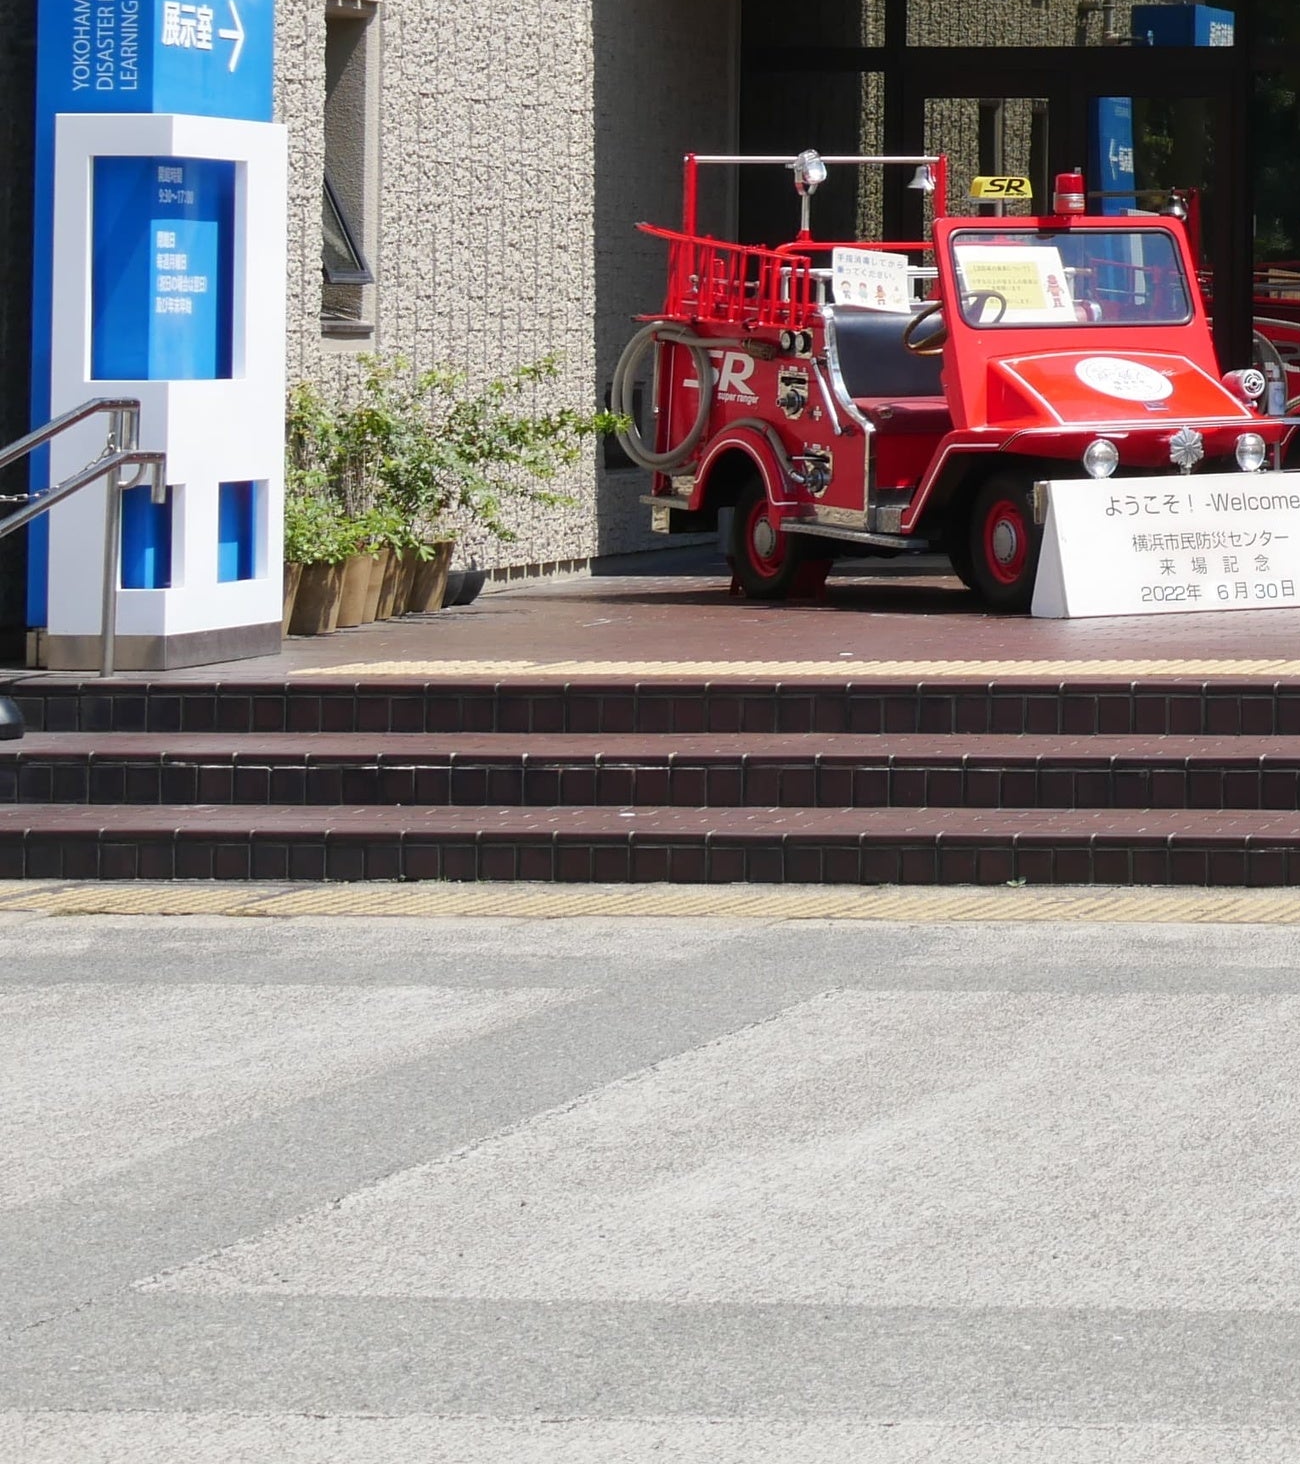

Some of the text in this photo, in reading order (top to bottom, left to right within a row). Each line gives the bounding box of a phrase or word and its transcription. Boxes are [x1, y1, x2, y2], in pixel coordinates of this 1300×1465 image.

[161, 0, 214, 51] 展示室
[96, 6, 115, 91] DISASTER
[120, 0, 139, 91] LEARNING
[984, 178, 1025, 193] SR
[1132, 529, 1289, 553] 横浜市民防災センター
[1159, 554, 1271, 576] 来場記念
